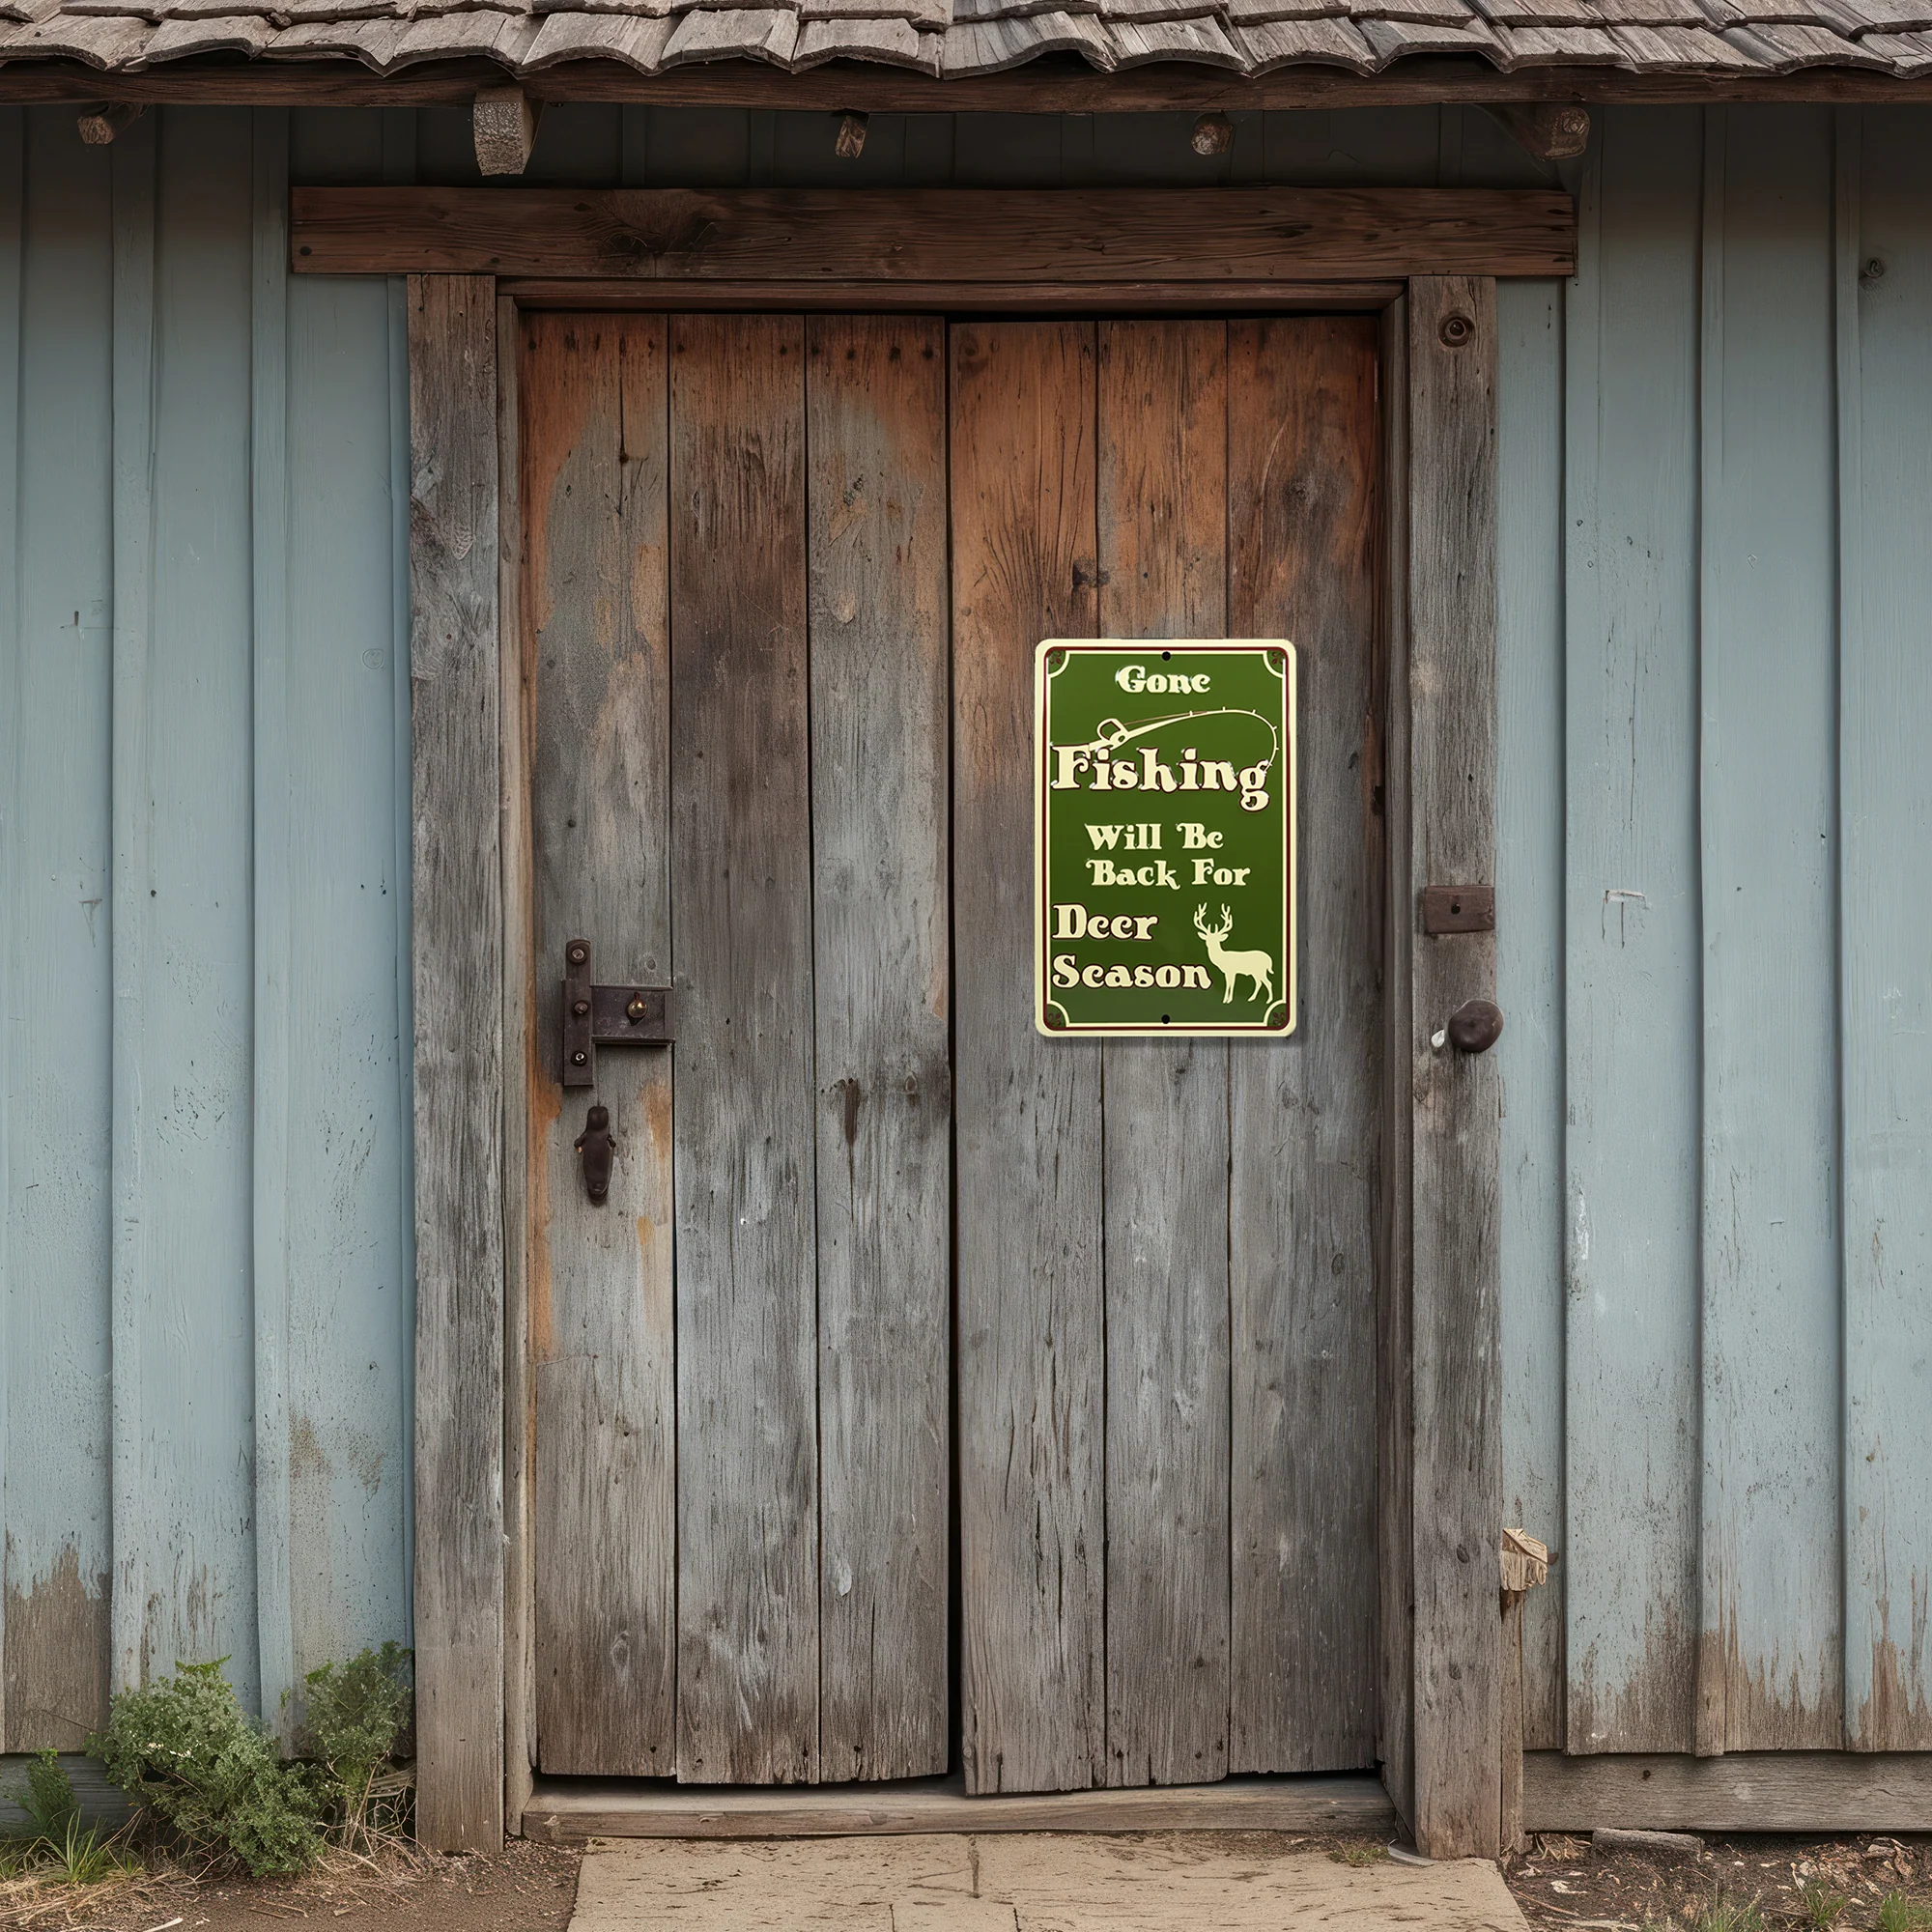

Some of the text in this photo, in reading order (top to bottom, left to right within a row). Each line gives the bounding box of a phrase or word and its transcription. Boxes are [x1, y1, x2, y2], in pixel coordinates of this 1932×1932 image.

[1116, 665, 1210, 694] Gone
[1050, 744, 1269, 811] Fishing
[1085, 823, 1223, 850] Will Be
[1086, 858, 1250, 889] Back For
[1052, 903, 1158, 941] Deer
[1051, 953, 1212, 989] Season
